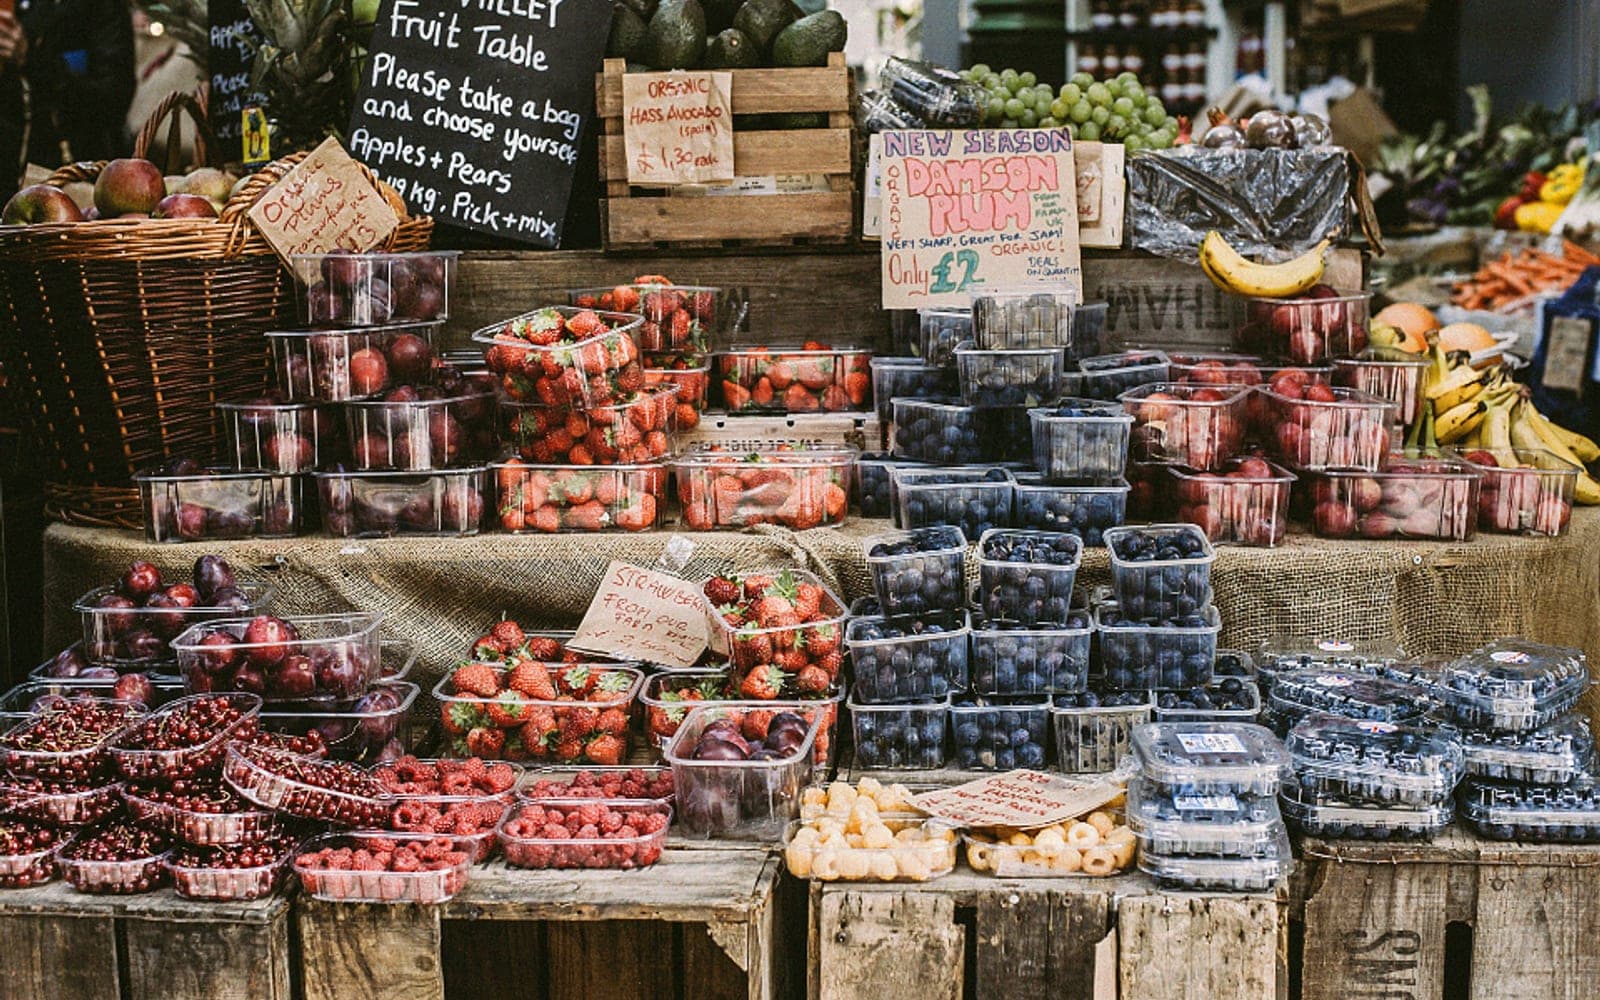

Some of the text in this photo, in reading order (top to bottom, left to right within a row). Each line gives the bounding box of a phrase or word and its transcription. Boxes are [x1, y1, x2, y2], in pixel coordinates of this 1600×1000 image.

[390, 0, 549, 72] Fruit Table
[372, 52, 581, 140] Please take a bag
[630, 106, 664, 126] HASS
[363, 98, 413, 122] and
[423, 106, 495, 141] choose
[350, 127, 426, 166] Apples
[448, 151, 512, 194] Pears
[883, 127, 1072, 157] NEW SEASON
[904, 155, 1060, 197] DAMSON
[929, 190, 1031, 237] PLUM
[886, 239, 914, 250] VERY
[960, 234, 995, 247] GREAT
[1001, 232, 1022, 242] FOR
[1029, 226, 1063, 241] JAM!
[888, 248, 986, 297] Only £2
[603, 592, 689, 631] FROM OUR
